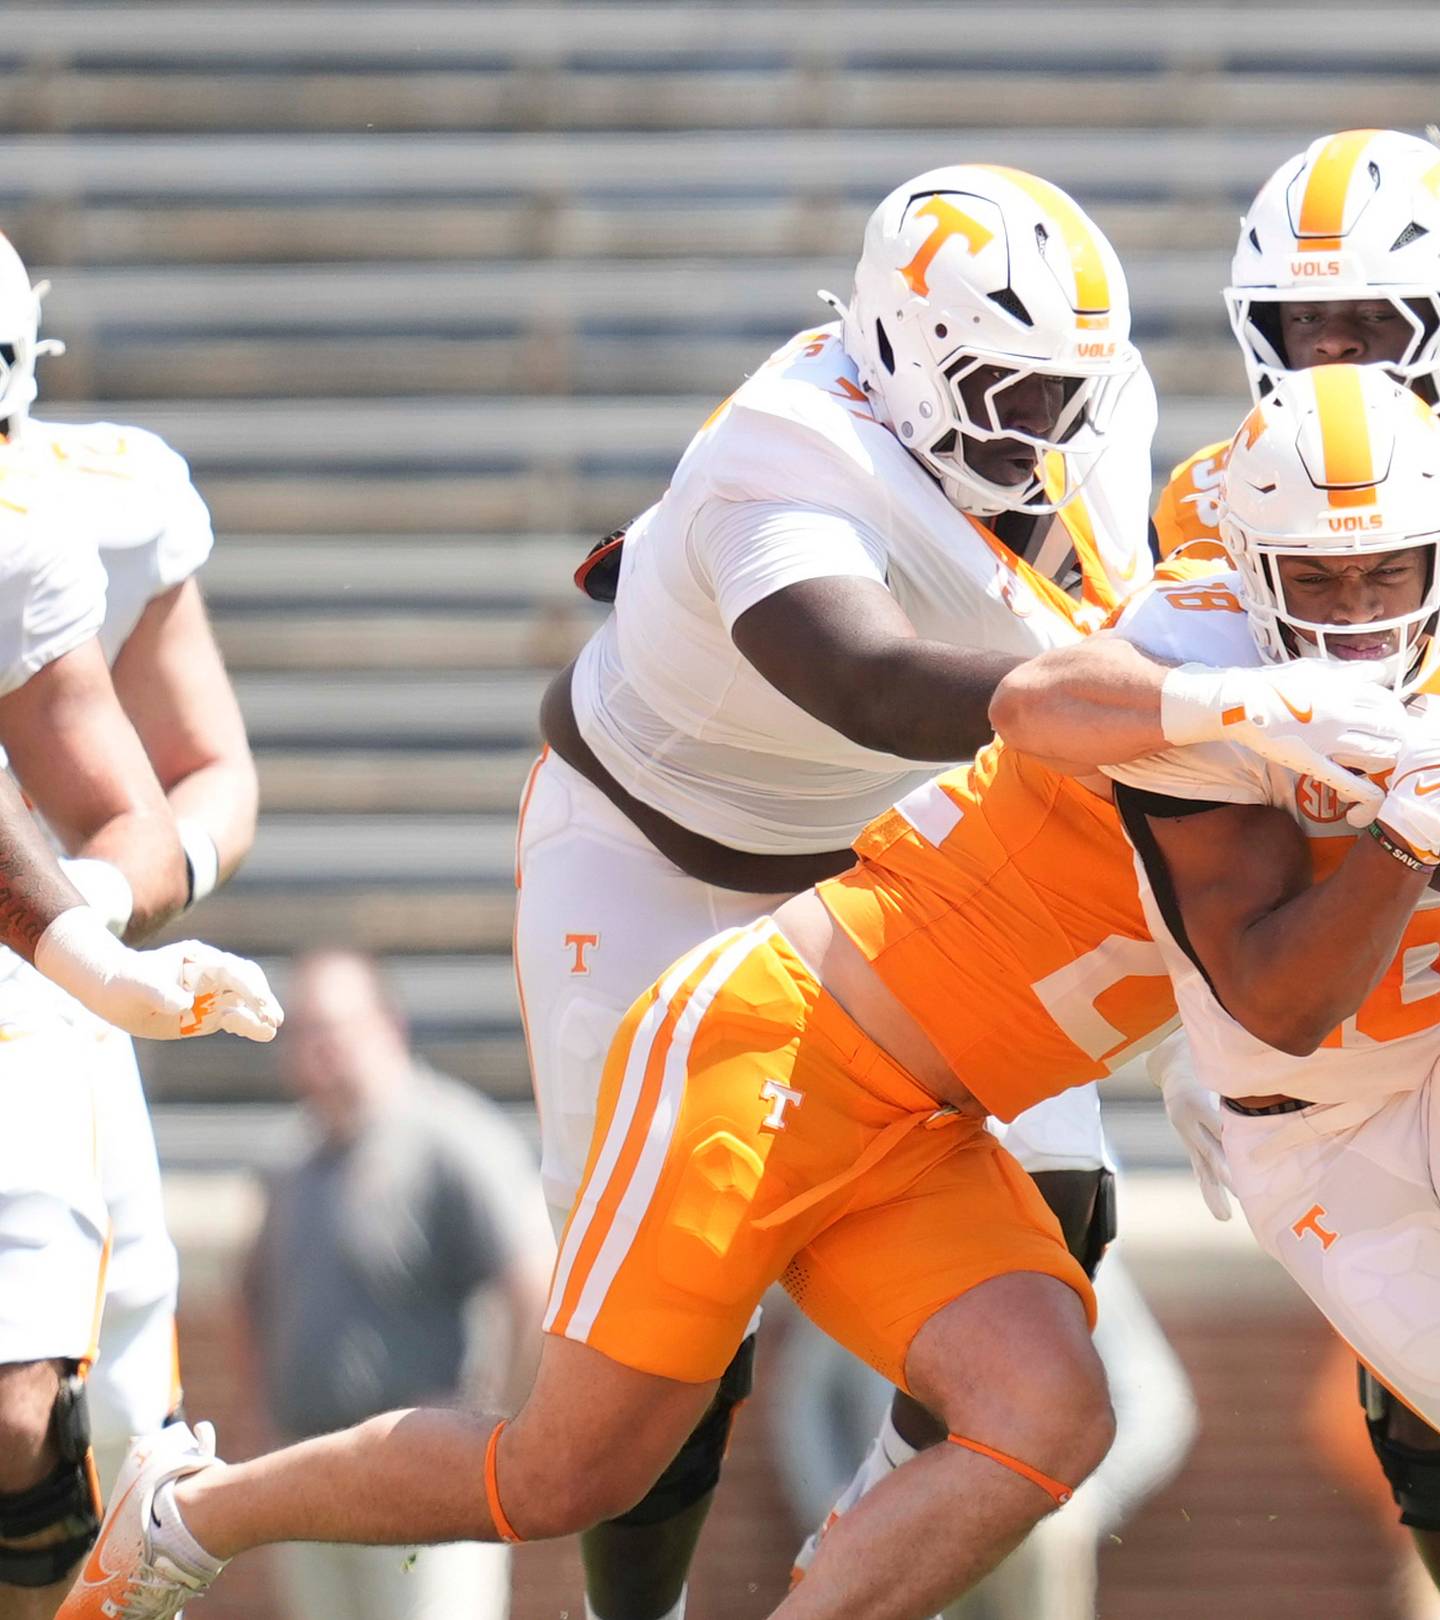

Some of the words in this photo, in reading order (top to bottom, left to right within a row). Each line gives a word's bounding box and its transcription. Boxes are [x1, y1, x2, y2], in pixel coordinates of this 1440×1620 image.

[896, 193, 995, 297] T
[1290, 261, 1340, 276] VOLS
[1328, 513, 1383, 533] VOLS
[1391, 847, 1422, 871] SAVE
[564, 933, 599, 974] T
[758, 1078, 804, 1130] T
[1291, 1203, 1339, 1251] T
